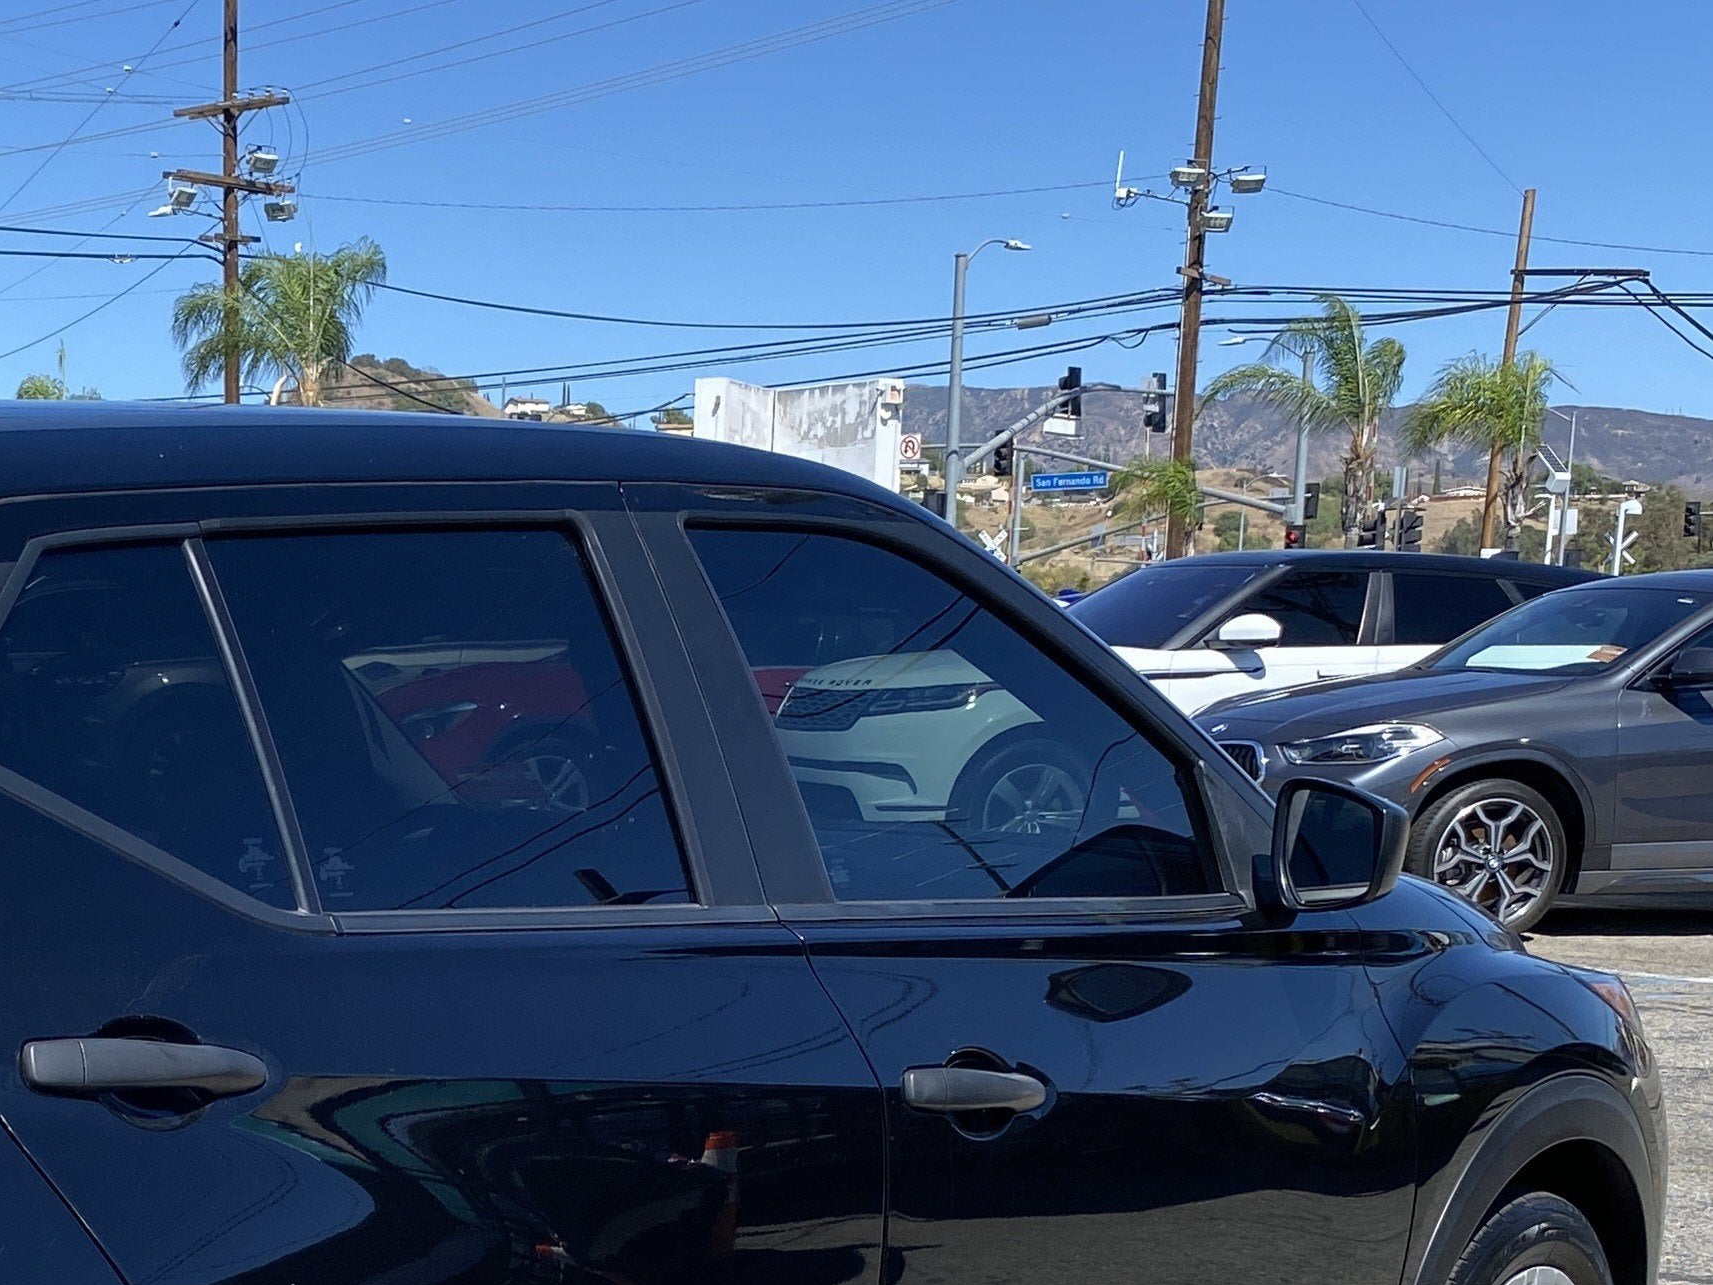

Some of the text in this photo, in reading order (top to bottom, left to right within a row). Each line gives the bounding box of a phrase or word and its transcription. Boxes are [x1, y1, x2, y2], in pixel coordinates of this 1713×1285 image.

[1035, 474, 1104, 487] San Fernando Rd
